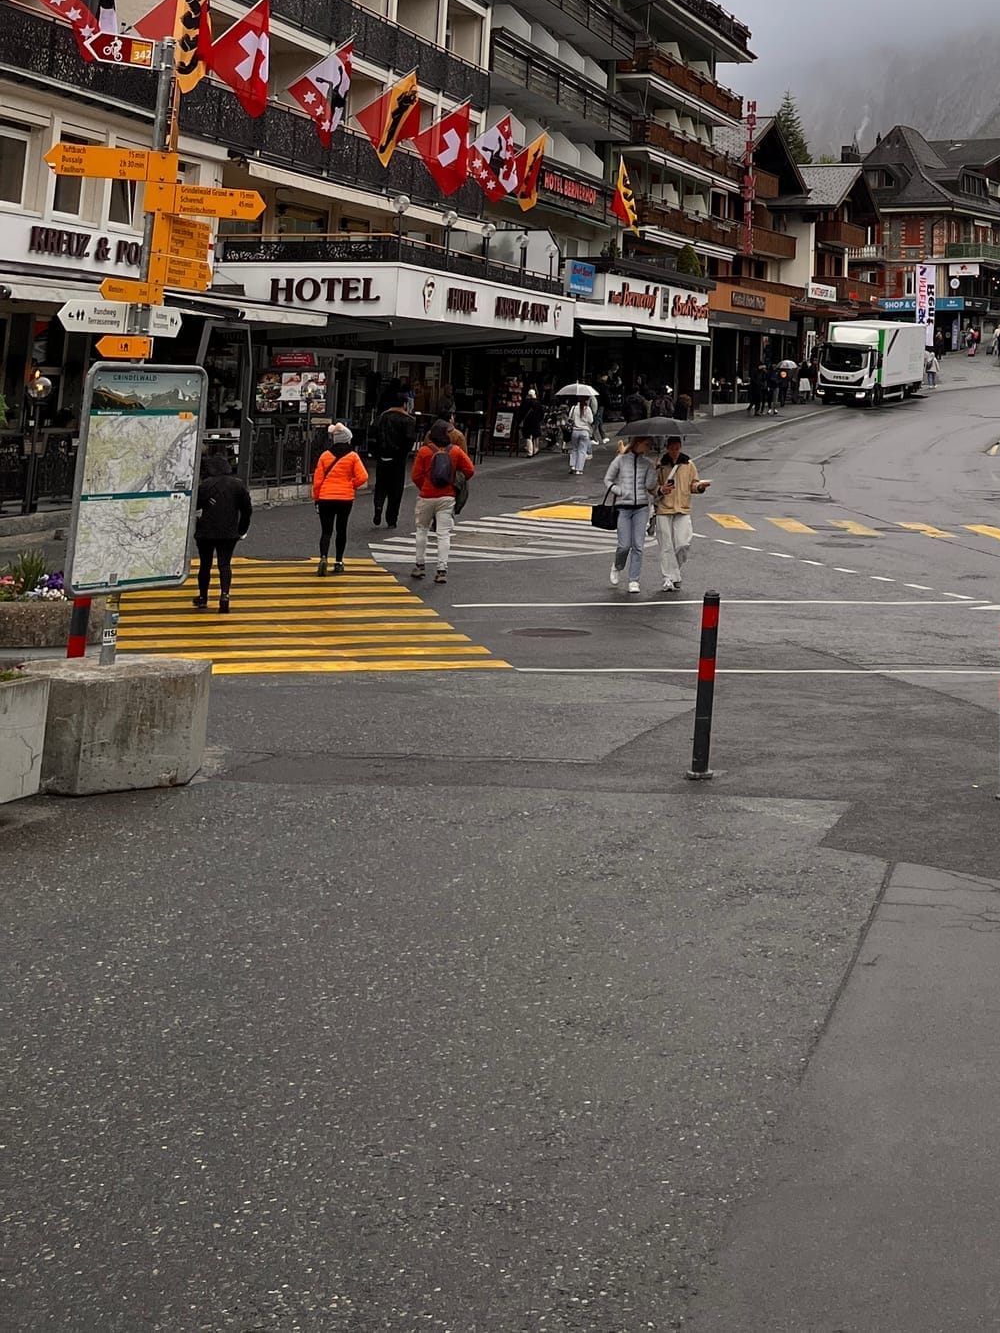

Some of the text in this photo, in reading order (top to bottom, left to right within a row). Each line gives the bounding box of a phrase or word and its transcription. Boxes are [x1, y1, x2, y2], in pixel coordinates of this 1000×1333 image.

[133, 49, 152, 60] 342
[545, 171, 563, 194] HOTEL
[29, 226, 143, 267] KREUZ & PO
[270, 277, 380, 302] HOTEL
[448, 287, 478, 313] HOTEL
[495, 296, 522, 319] KREUZ
[529, 302, 550, 322] POST
[113, 374, 158, 382] GRINDELWALD
